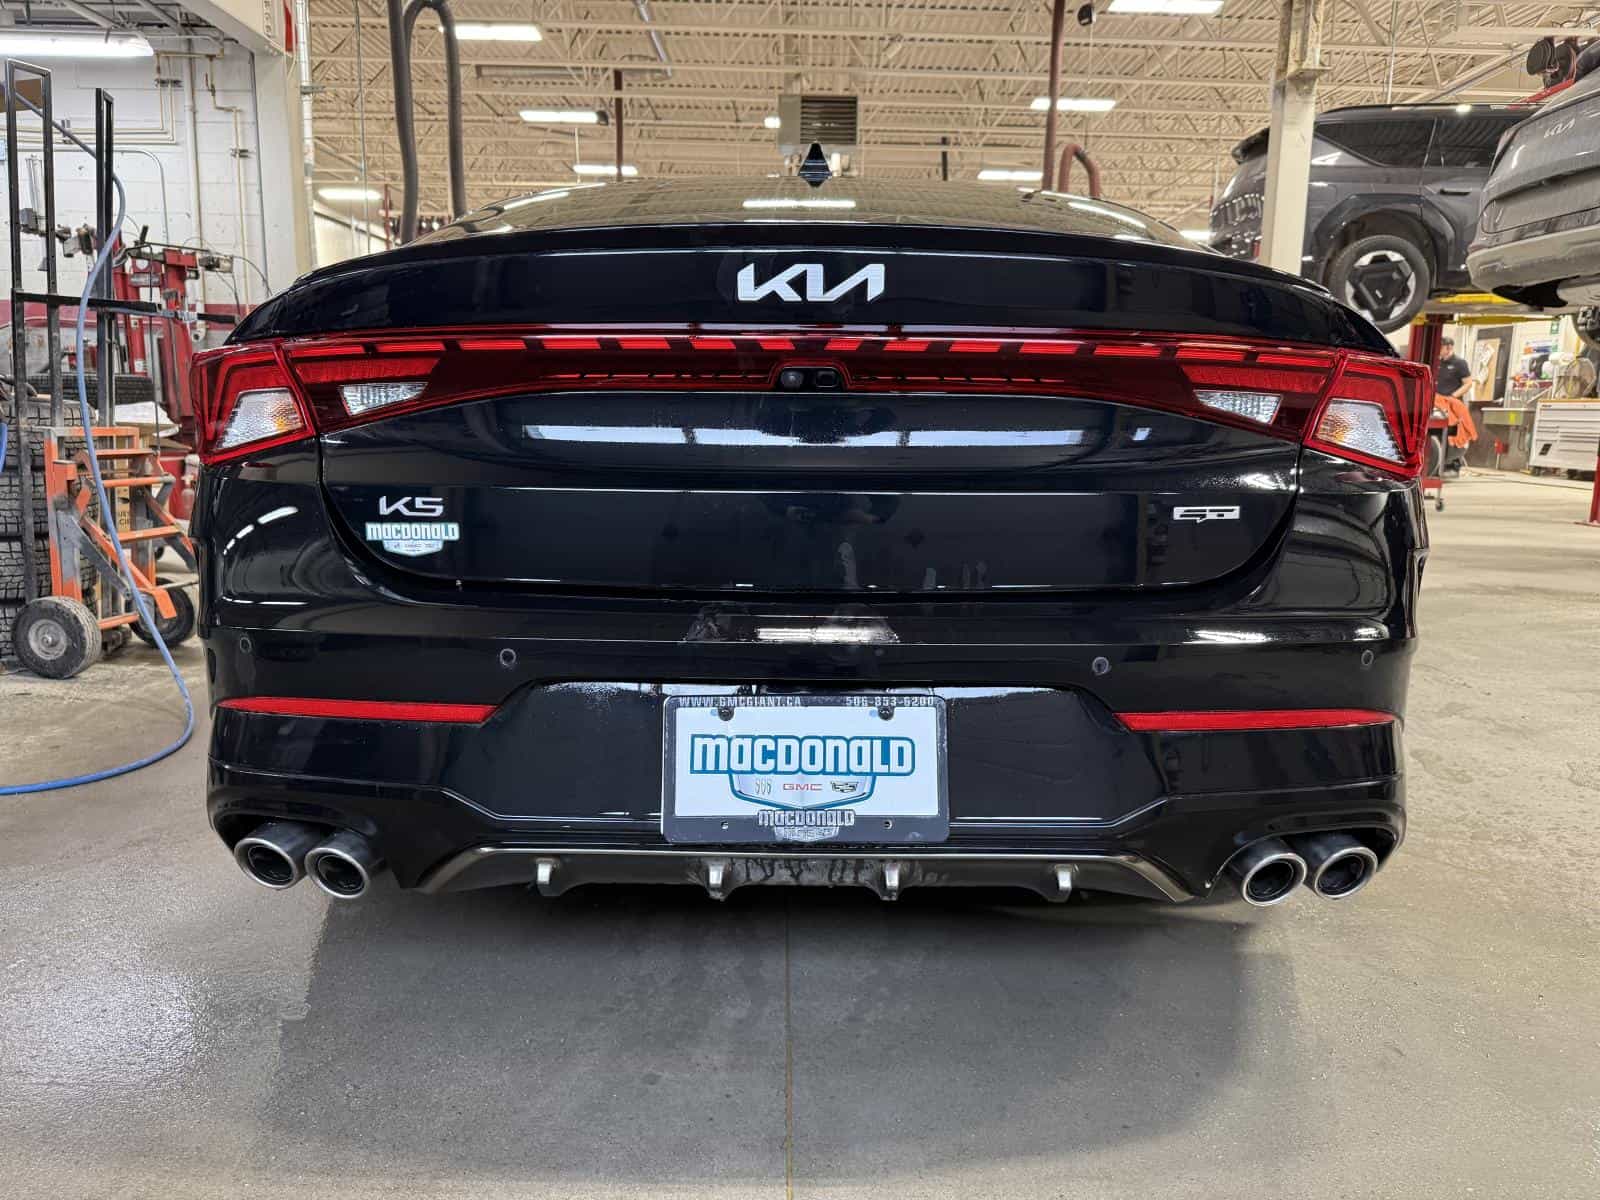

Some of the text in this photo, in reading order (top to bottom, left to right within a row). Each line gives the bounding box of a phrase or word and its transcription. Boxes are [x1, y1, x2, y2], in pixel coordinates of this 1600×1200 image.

[737, 263, 885, 302] KIA
[379, 495, 444, 517] K5
[679, 696, 802, 708] WWW.GMCGIANT.CA
[783, 783, 823, 791] GMC
